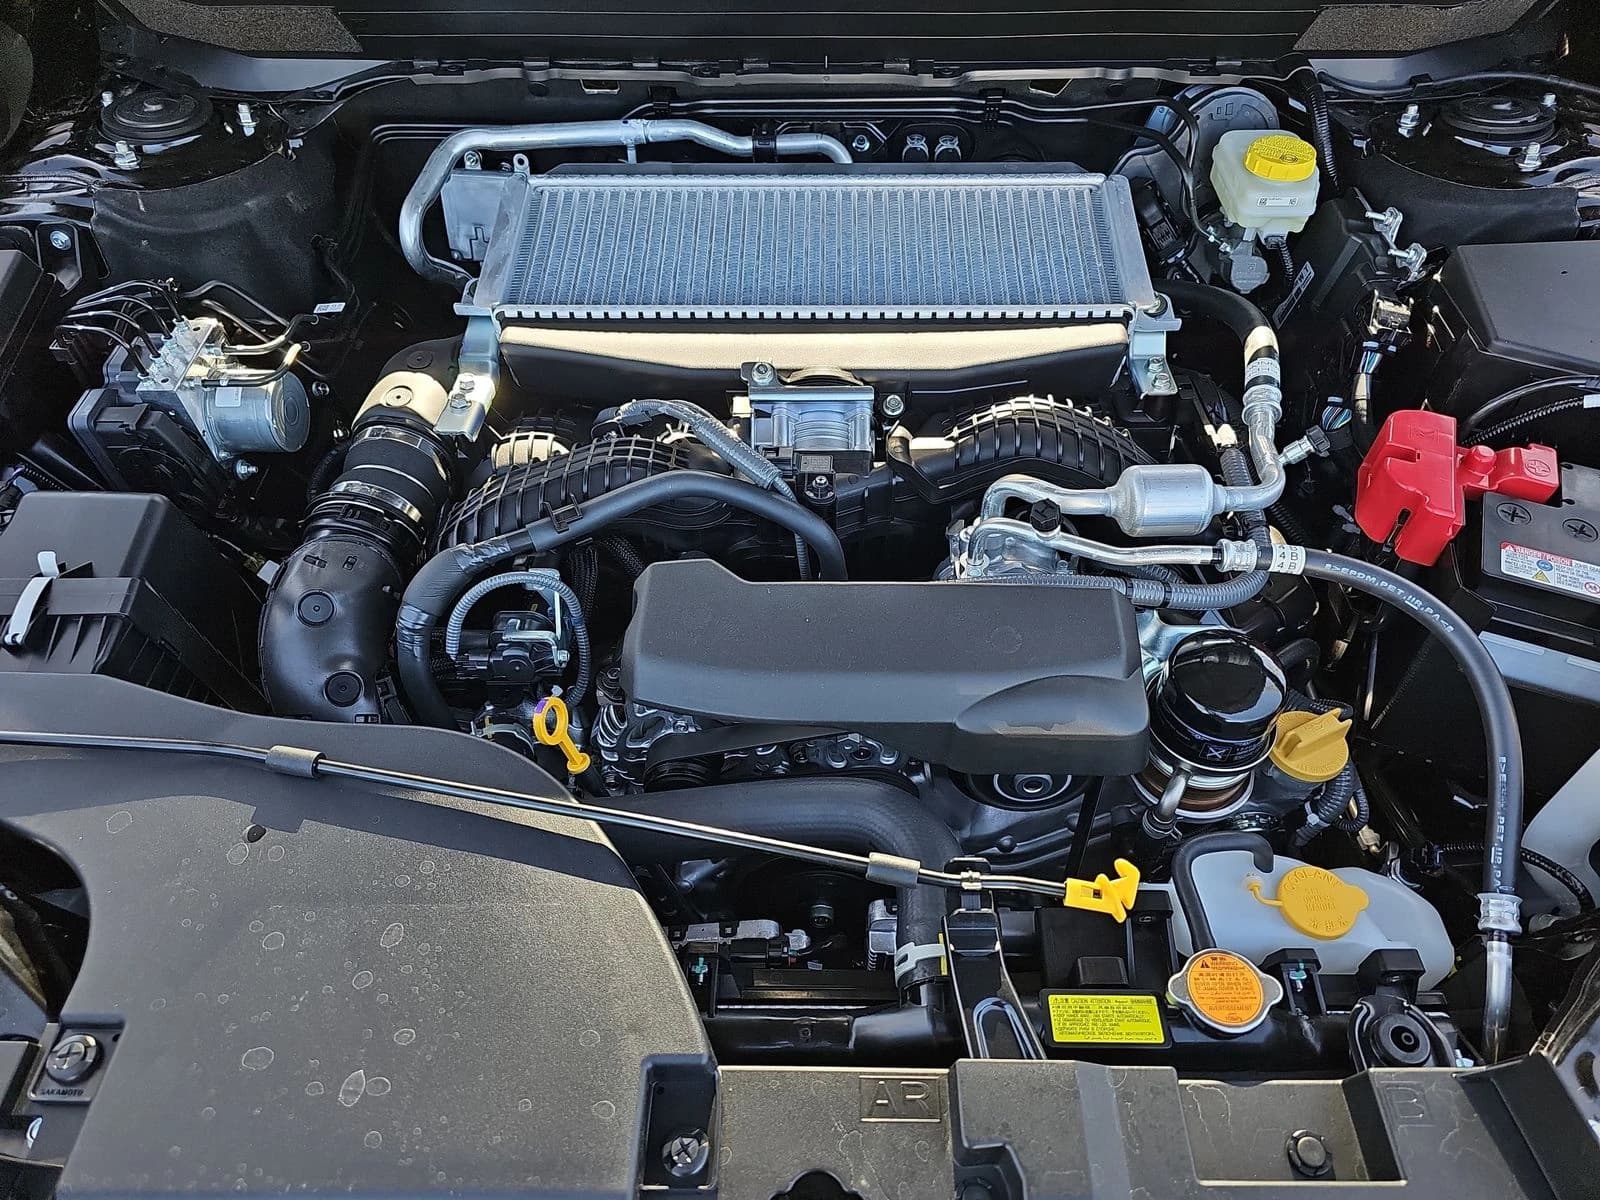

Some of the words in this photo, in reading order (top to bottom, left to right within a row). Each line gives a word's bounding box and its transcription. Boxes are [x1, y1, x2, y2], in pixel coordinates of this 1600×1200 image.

[1515, 545, 1541, 559] DANGER
[1283, 869, 1344, 892] COOLANT
[40, 1088, 84, 1096] SAKAMOTO
[867, 1080, 932, 1117] AR
